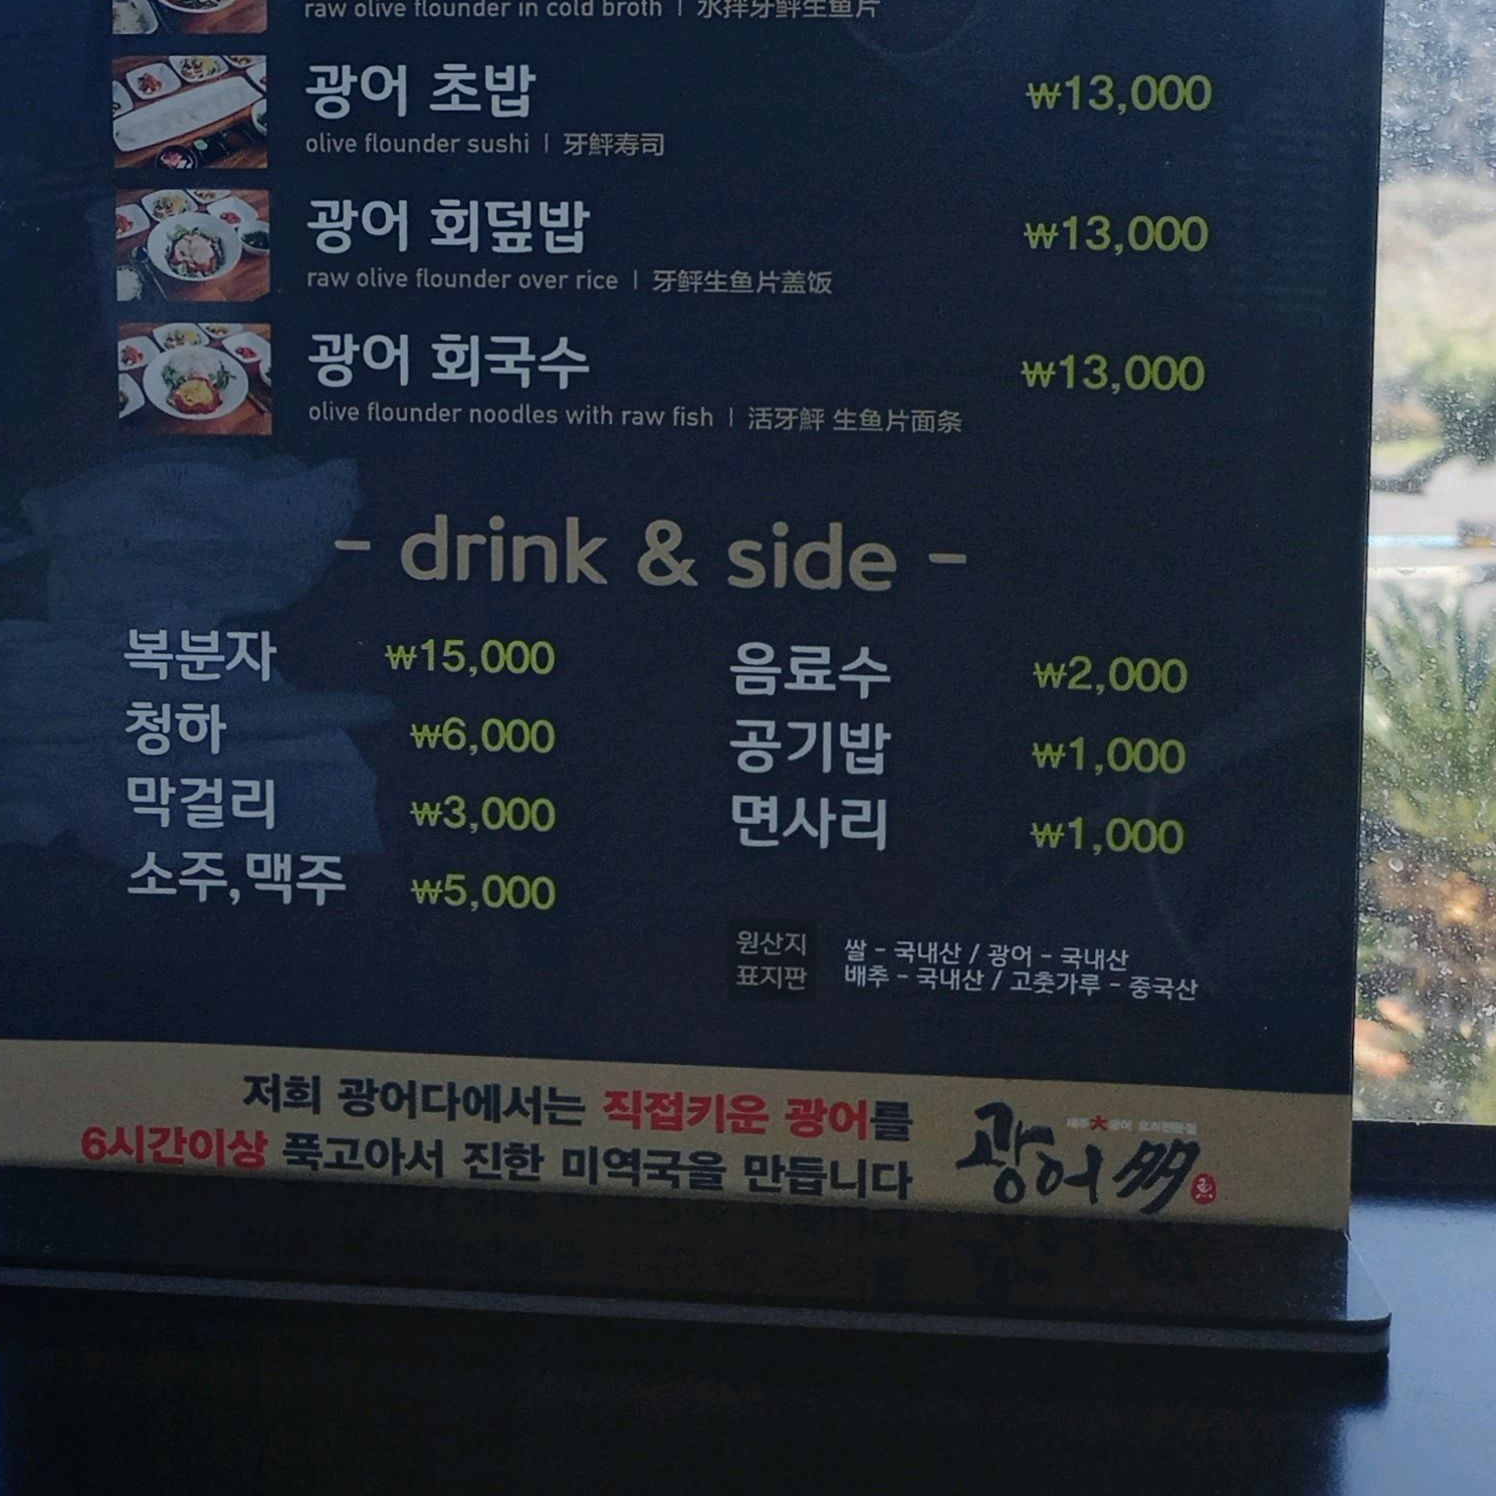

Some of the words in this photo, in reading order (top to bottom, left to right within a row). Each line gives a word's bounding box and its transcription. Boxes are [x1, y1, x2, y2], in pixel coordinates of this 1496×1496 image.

[305, 3, 347, 18] raw
[306, 65, 406, 119] 광어
[430, 64, 536, 117] 초밥
[1026, 75, 1212, 115] ₩13,000
[306, 133, 357, 153] olive
[365, 133, 460, 153] flounder
[467, 133, 529, 153] sushi
[307, 200, 407, 253] 광어
[431, 199, 590, 253] 회덮밥
[1024, 215, 1208, 255] ₩13,000
[308, 272, 349, 287] raw
[357, 267, 407, 287] olive
[416, 268, 511, 288] flounder
[519, 274, 568, 289] over
[577, 269, 618, 289] rice
[309, 334, 408, 387] 광어
[432, 334, 589, 389] 회국수
[1021, 354, 1205, 394] ₩13,000
[309, 401, 359, 421] olive
[368, 402, 462, 422] flounder
[470, 404, 558, 424] noodles
[566, 405, 613, 424] with
[622, 411, 665, 425] raw
[673, 406, 713, 426] fish
[401, 514, 607, 584] drink
[638, 520, 698, 586] &
[728, 521, 897, 591] side
[124, 629, 277, 681] 복분자
[385, 639, 555, 677] ₩15,000
[730, 642, 891, 699] 음료수
[1033, 656, 1187, 695] ₩2,000
[126, 702, 227, 755] 청하
[410, 717, 555, 755] ₩6,000
[730, 720, 891, 775] 공기밥
[1032, 737, 1185, 775] ₩1,000
[128, 777, 274, 829] 막걸리
[410, 795, 555, 833] ₩3,000
[732, 795, 886, 851] 면사리
[1030, 817, 1184, 855] ₩1,000
[128, 852, 346, 906] 소주,맥주
[411, 873, 555, 911] ₩5,000
[737, 931, 806, 956] 원산지
[845, 939, 867, 961] 쌀
[894, 941, 962, 965] 국내산
[988, 944, 1031, 967] 광어
[1061, 947, 1129, 971] 국내산
[737, 965, 807, 990] 표지판
[845, 965, 889, 988] 배추
[917, 968, 984, 991] 국내산
[1010, 971, 1100, 996] 고춧가루
[1129, 976, 1198, 1001] 중국산
[243, 1073, 320, 1114] 저희
[338, 1078, 585, 1126] 광어다에서는
[603, 1089, 769, 1132] 직접키운
[785, 1098, 913, 1142] 광어를
[81, 1125, 269, 1171] 6시간이상
[283, 1131, 444, 1178] 푹고아서
[462, 1140, 544, 1182] 진한
[562, 1145, 727, 1192] 미역국을
[744, 1154, 912, 1200] 만듭니다
